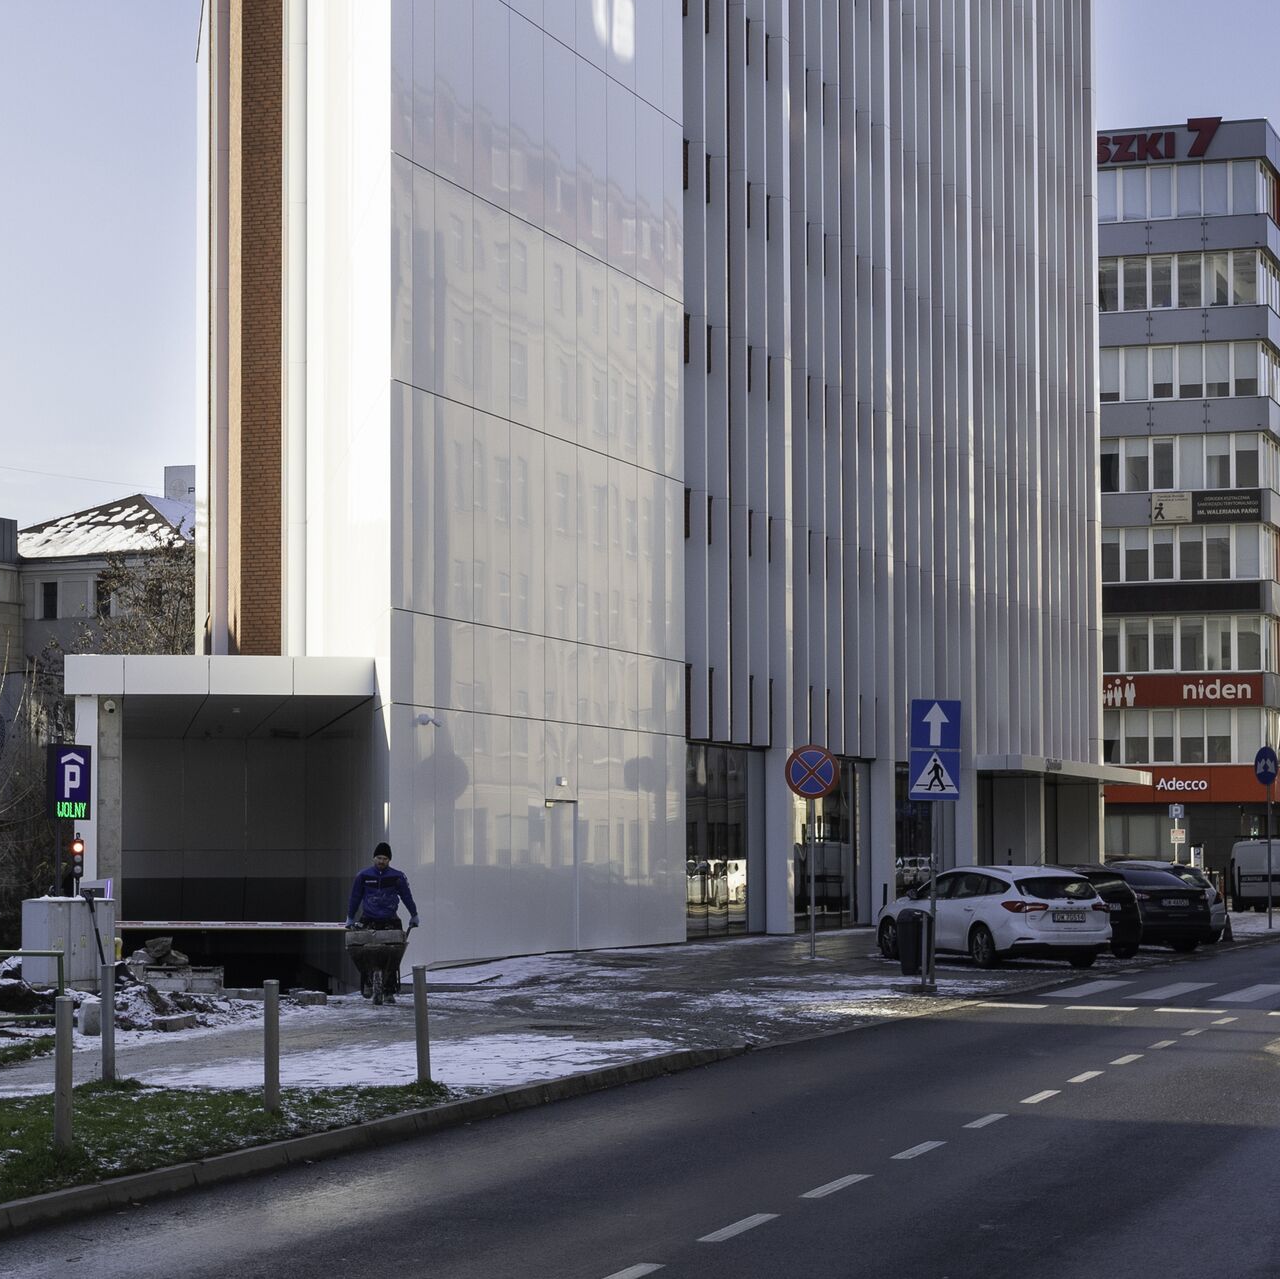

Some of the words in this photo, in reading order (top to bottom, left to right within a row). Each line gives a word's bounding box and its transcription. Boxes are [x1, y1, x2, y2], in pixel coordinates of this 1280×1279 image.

[1186, 116, 1223, 158] 7
[1182, 679, 1252, 700] niden
[64, 764, 81, 798] P
[1155, 777, 1208, 791] Adecco
[57, 801, 87, 818] WOLNY
